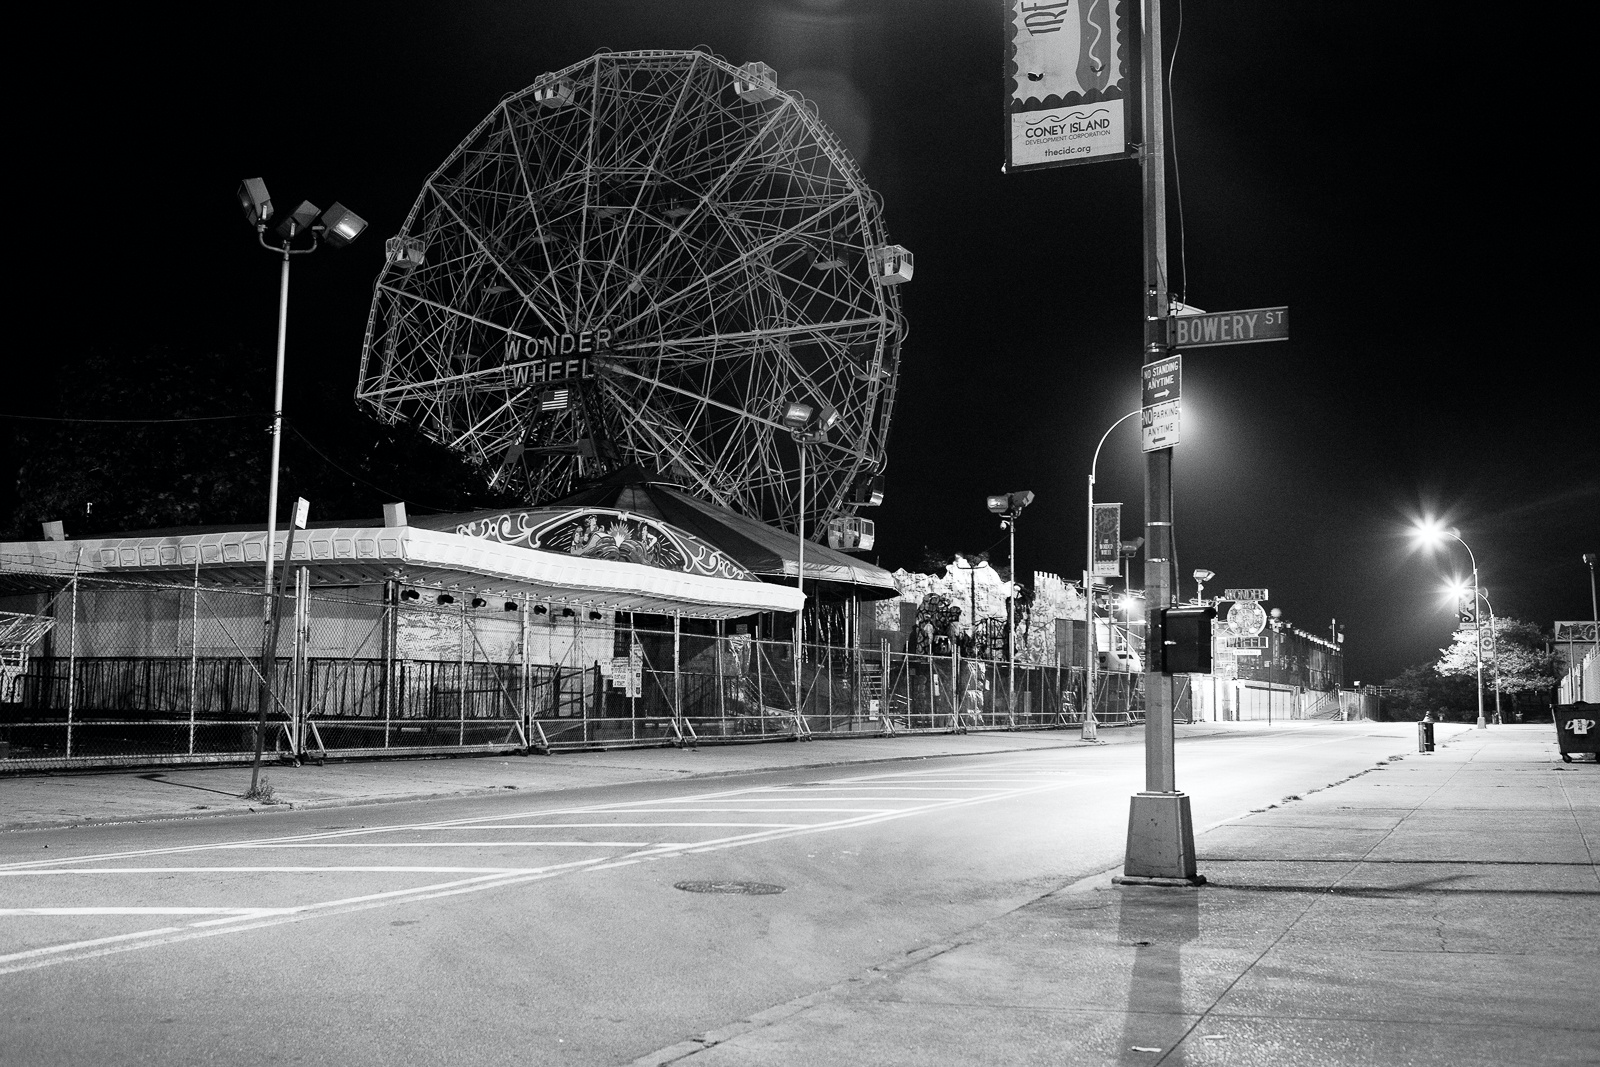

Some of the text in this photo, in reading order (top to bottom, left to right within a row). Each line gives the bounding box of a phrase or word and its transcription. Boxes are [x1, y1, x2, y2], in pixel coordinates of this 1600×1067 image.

[1025, 119, 1110, 138] CONEY ISLAND
[1025, 130, 1111, 146] DEVELOPMENT CORPORATION
[1044, 145, 1091, 157] thecidc.org
[1177, 311, 1284, 344] BOWERY ST
[504, 329, 612, 361] WONDER
[1144, 361, 1179, 380] NO STANDING
[1147, 374, 1175, 391] ANYTIME
[1142, 405, 1179, 427] NO PARKING
[1147, 422, 1174, 437] ANYTIME
